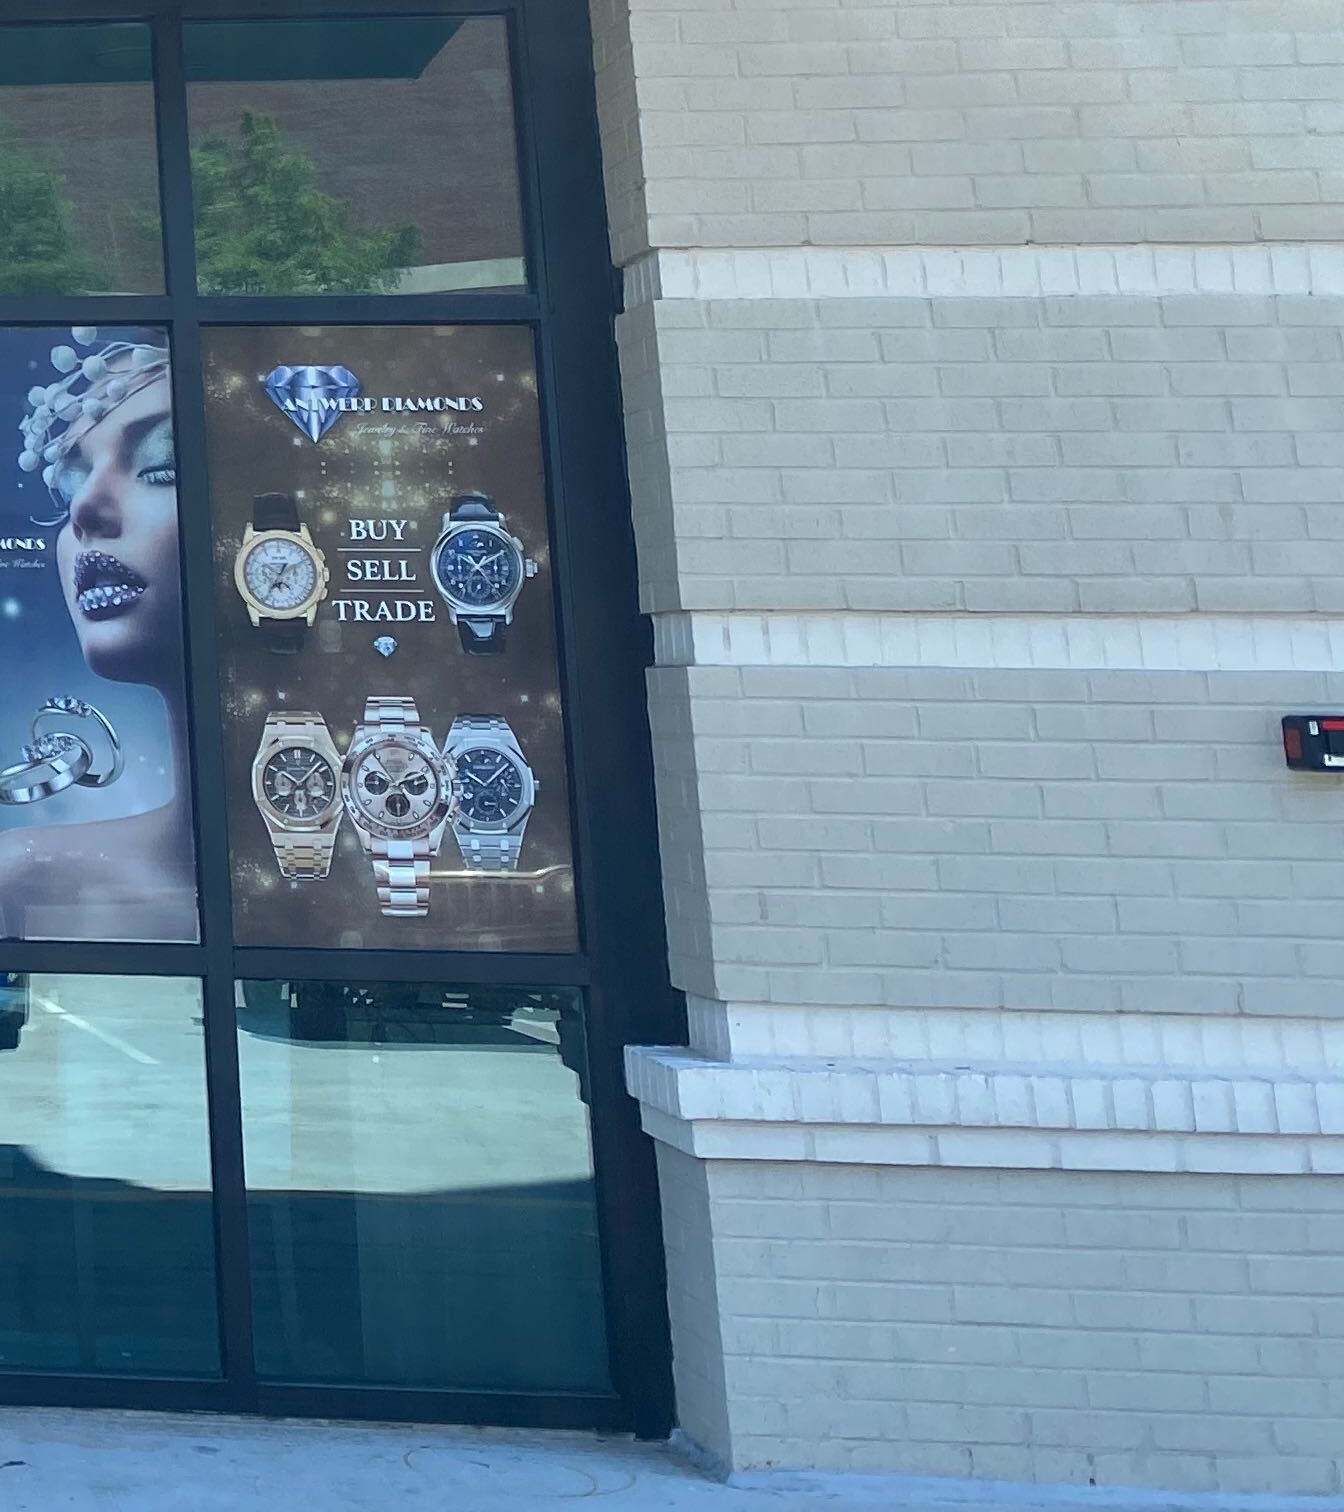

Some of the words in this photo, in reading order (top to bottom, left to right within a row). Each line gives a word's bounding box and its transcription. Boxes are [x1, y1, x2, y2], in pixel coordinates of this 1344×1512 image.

[282, 396, 378, 412] ANTWERP
[381, 396, 484, 412] DIAMONDS
[348, 519, 408, 541] BUY
[346, 559, 417, 581] SELL
[331, 600, 436, 622] TRADE
